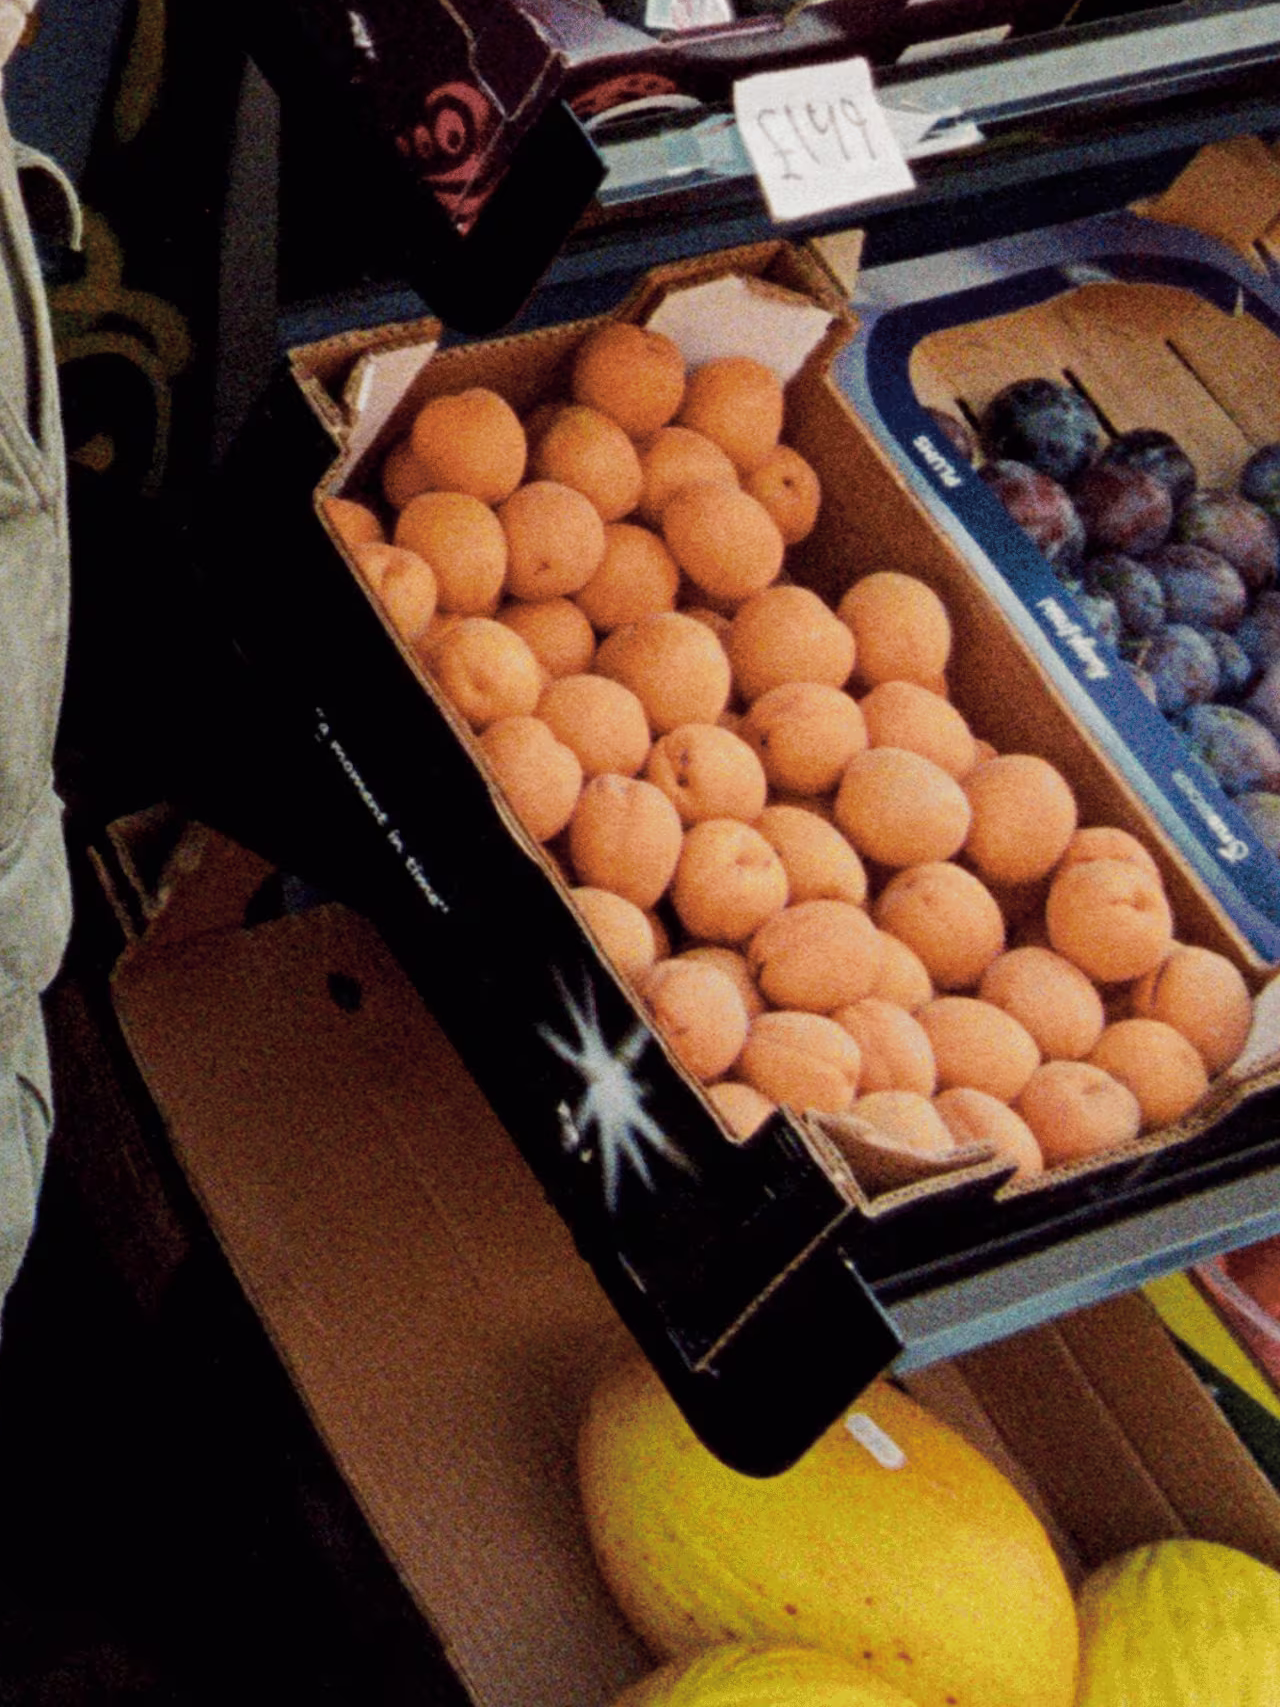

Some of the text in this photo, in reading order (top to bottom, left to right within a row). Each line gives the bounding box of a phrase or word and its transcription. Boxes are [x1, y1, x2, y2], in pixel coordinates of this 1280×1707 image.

[912, 434, 961, 487] PLUMS
[329, 739, 391, 829] moment
[386, 827, 405, 855] in
